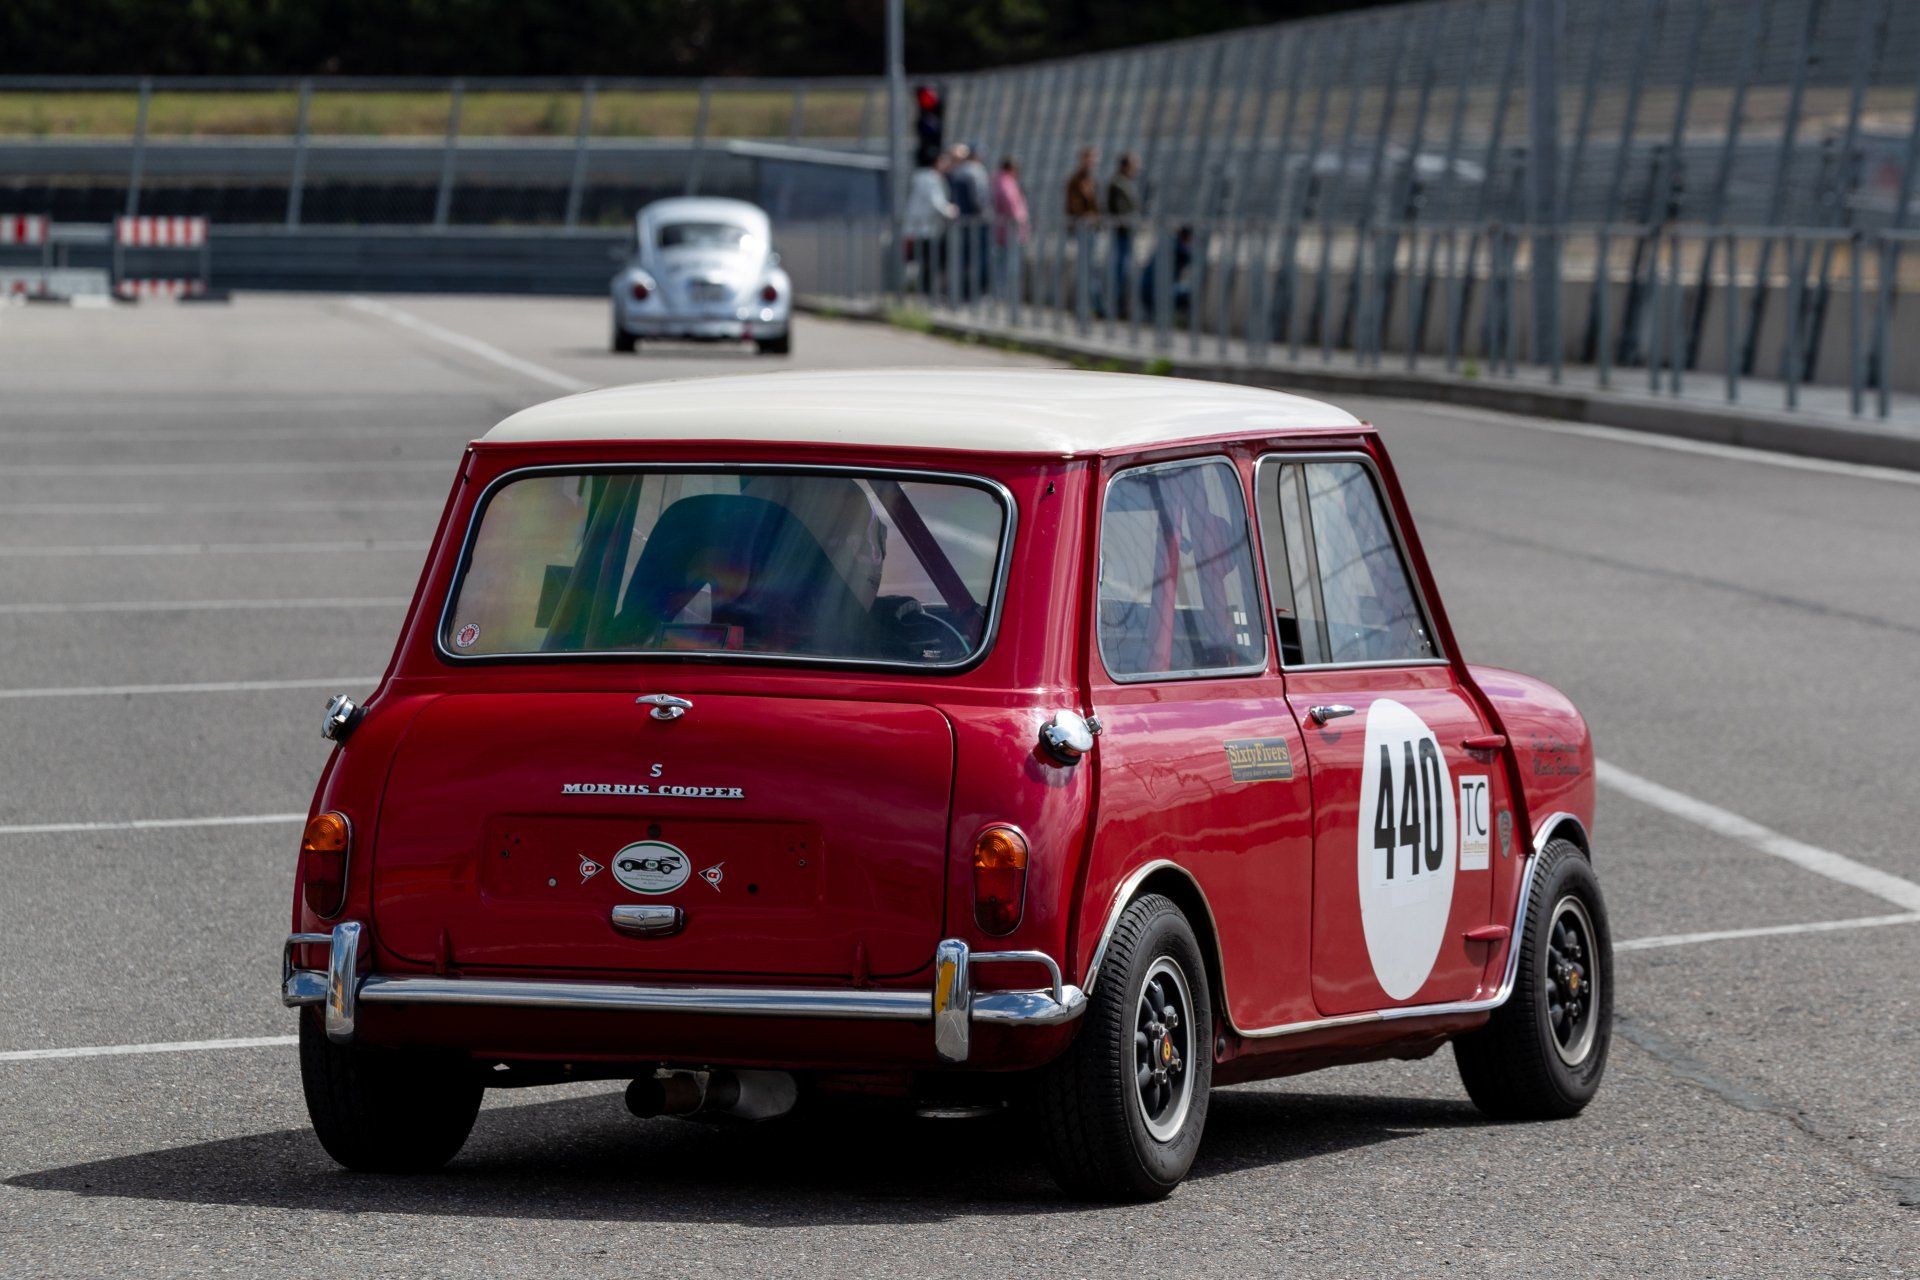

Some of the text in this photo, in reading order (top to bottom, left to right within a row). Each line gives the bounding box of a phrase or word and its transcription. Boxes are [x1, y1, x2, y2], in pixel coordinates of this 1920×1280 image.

[1229, 743, 1288, 767] SixtyFivers
[650, 763, 662, 777] S
[562, 783, 743, 798] MORRIS COOPER
[1374, 737, 1443, 880] 440
[1462, 782, 1487, 836] TC
